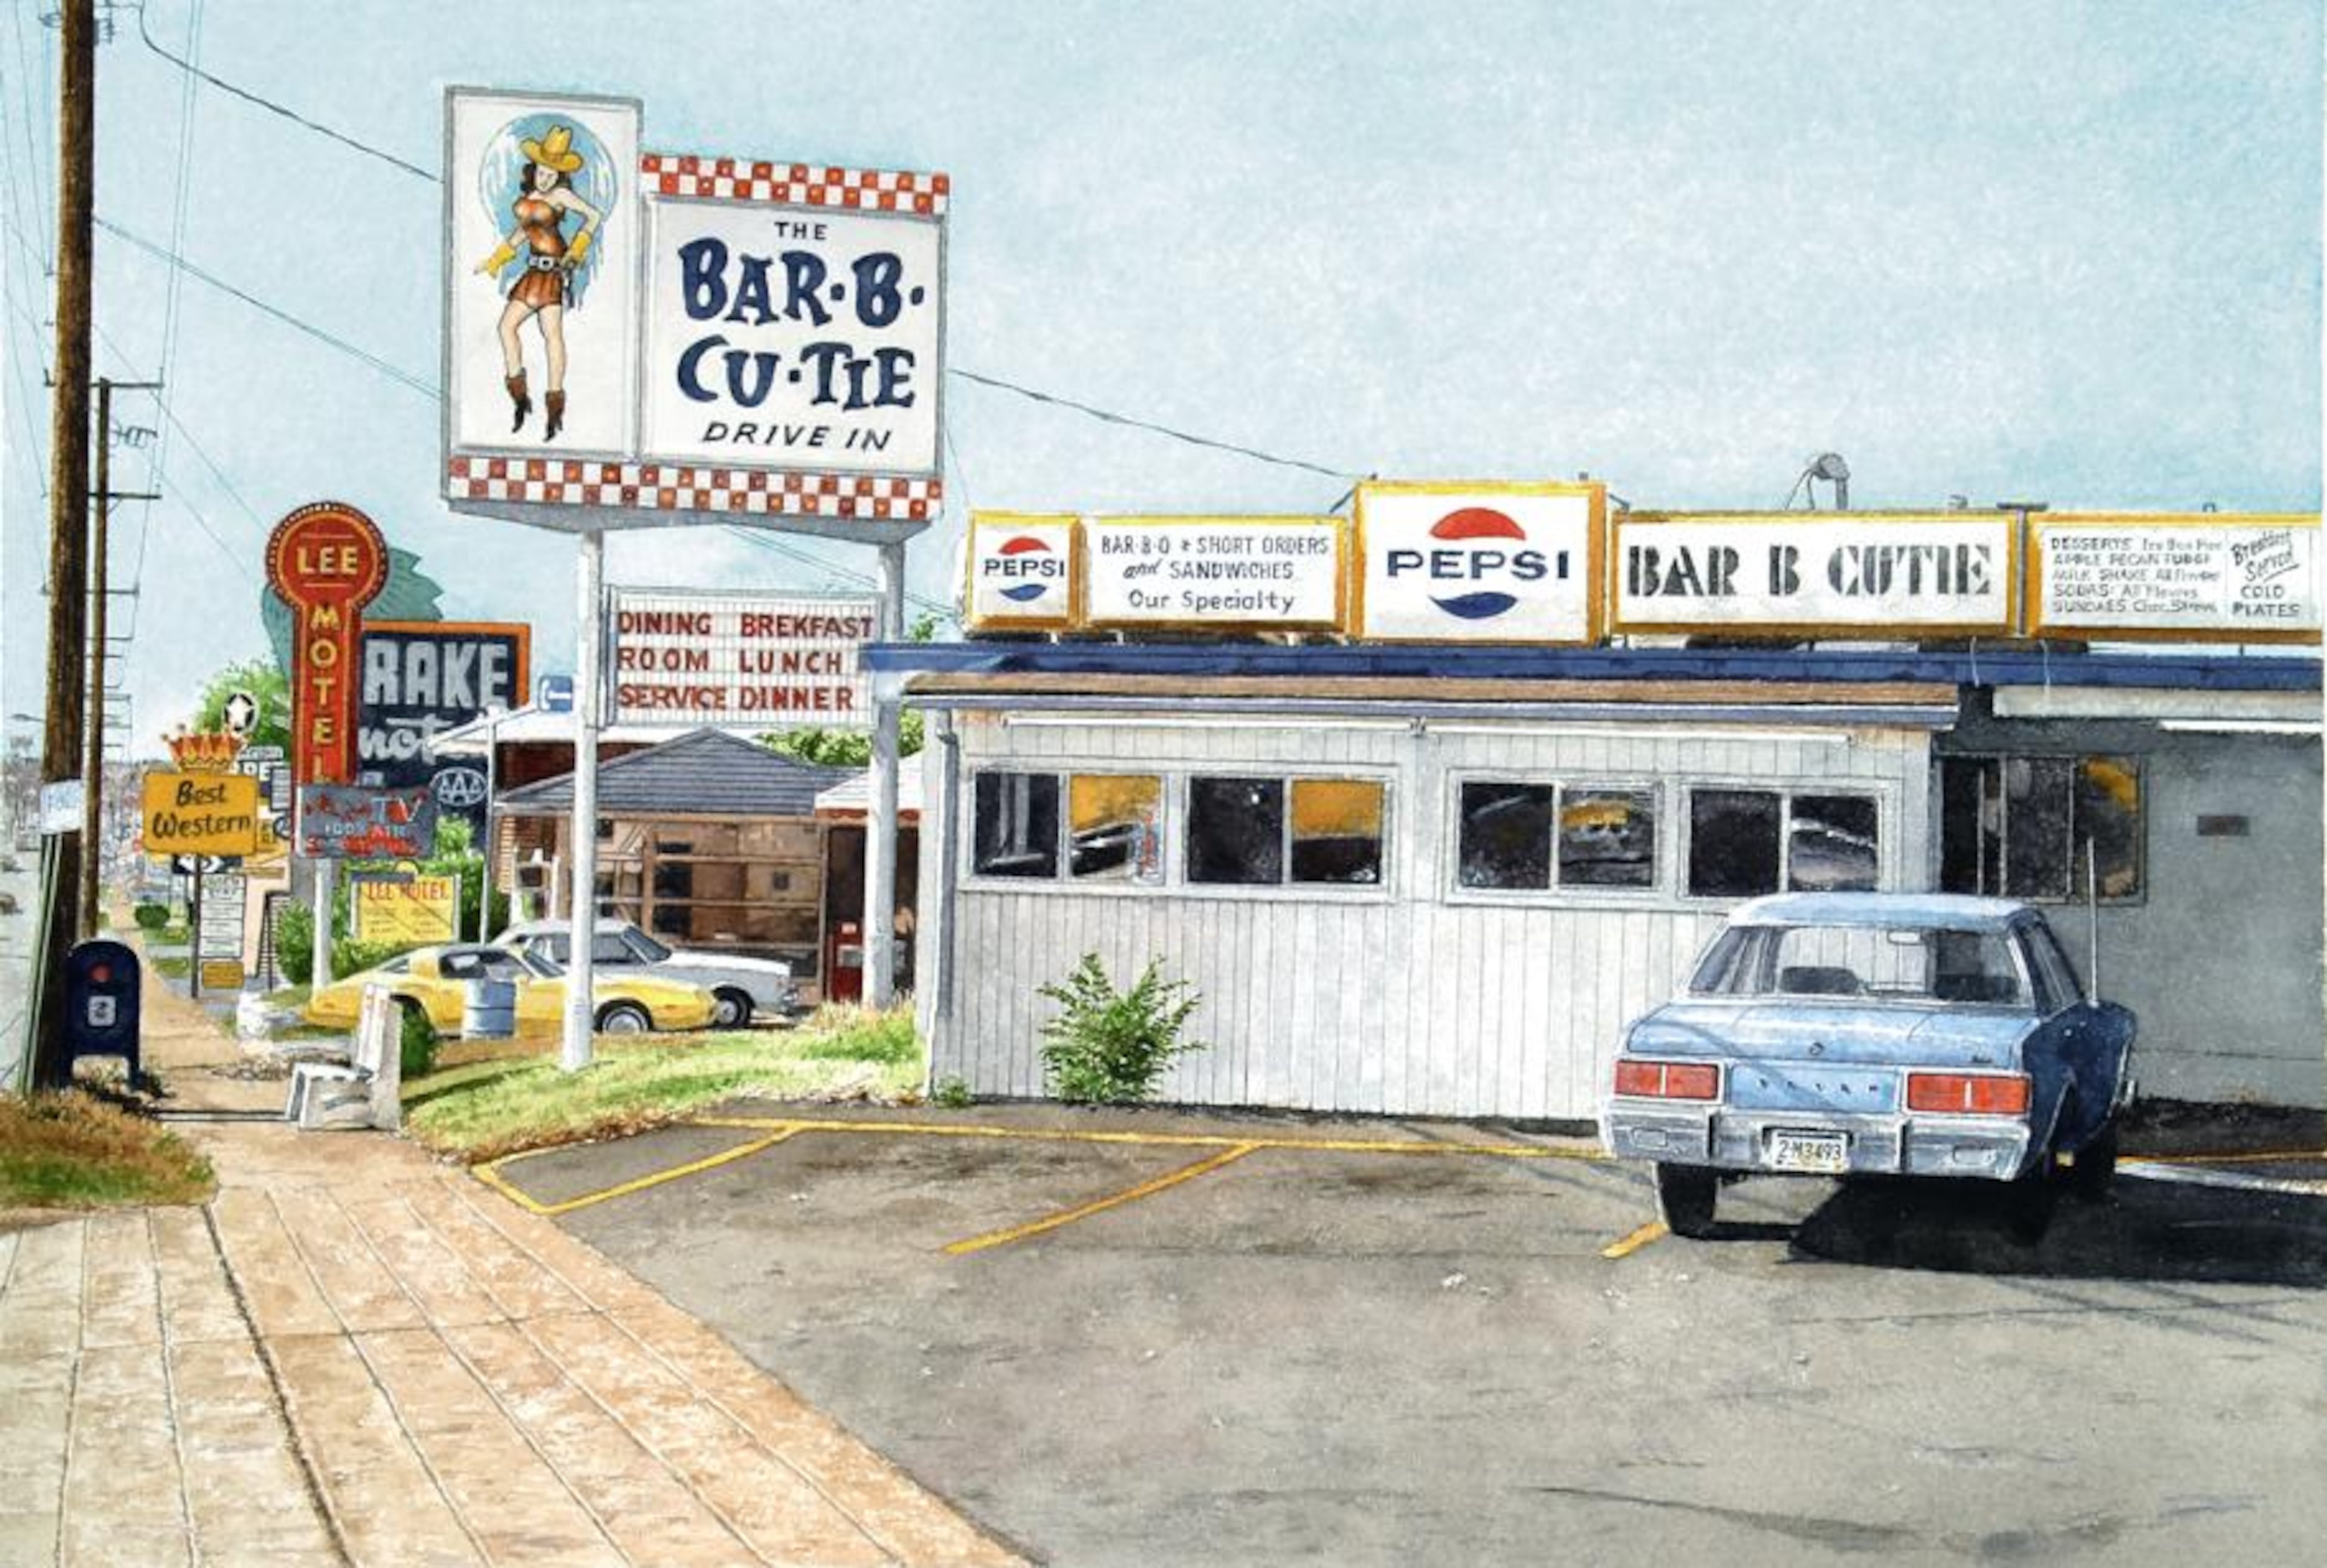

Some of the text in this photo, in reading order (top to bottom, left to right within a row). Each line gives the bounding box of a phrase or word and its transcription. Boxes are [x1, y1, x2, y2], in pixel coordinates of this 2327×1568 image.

[774, 221, 827, 241] THE
[702, 422, 892, 451] DRIVE IN
[1196, 535, 1253, 554] SHORT
[1262, 536, 1330, 554] ORDERS
[2051, 536, 2132, 551] DESSERTS
[297, 546, 358, 576] LEE
[984, 559, 1065, 577] PEPSI
[1122, 558, 1294, 580] and SANDWICHES
[1387, 550, 1569, 580] PEPSI
[1628, 543, 1992, 598] BAR B CUTIE
[2052, 553, 2102, 566] APPLE
[2108, 553, 2160, 566] PECAN
[1128, 589, 1295, 614] Our Specialty
[2240, 583, 2285, 600] COLD
[2052, 600, 2128, 613] SUNDAES
[2232, 602, 2302, 618] PLATES
[618, 612, 873, 638] DINING BREKFAST
[618, 646, 842, 674] ROOM LUNCH
[619, 684, 854, 711] SERVICE DINNER
[175, 780, 228, 806] Best
[153, 812, 251, 839] Western
